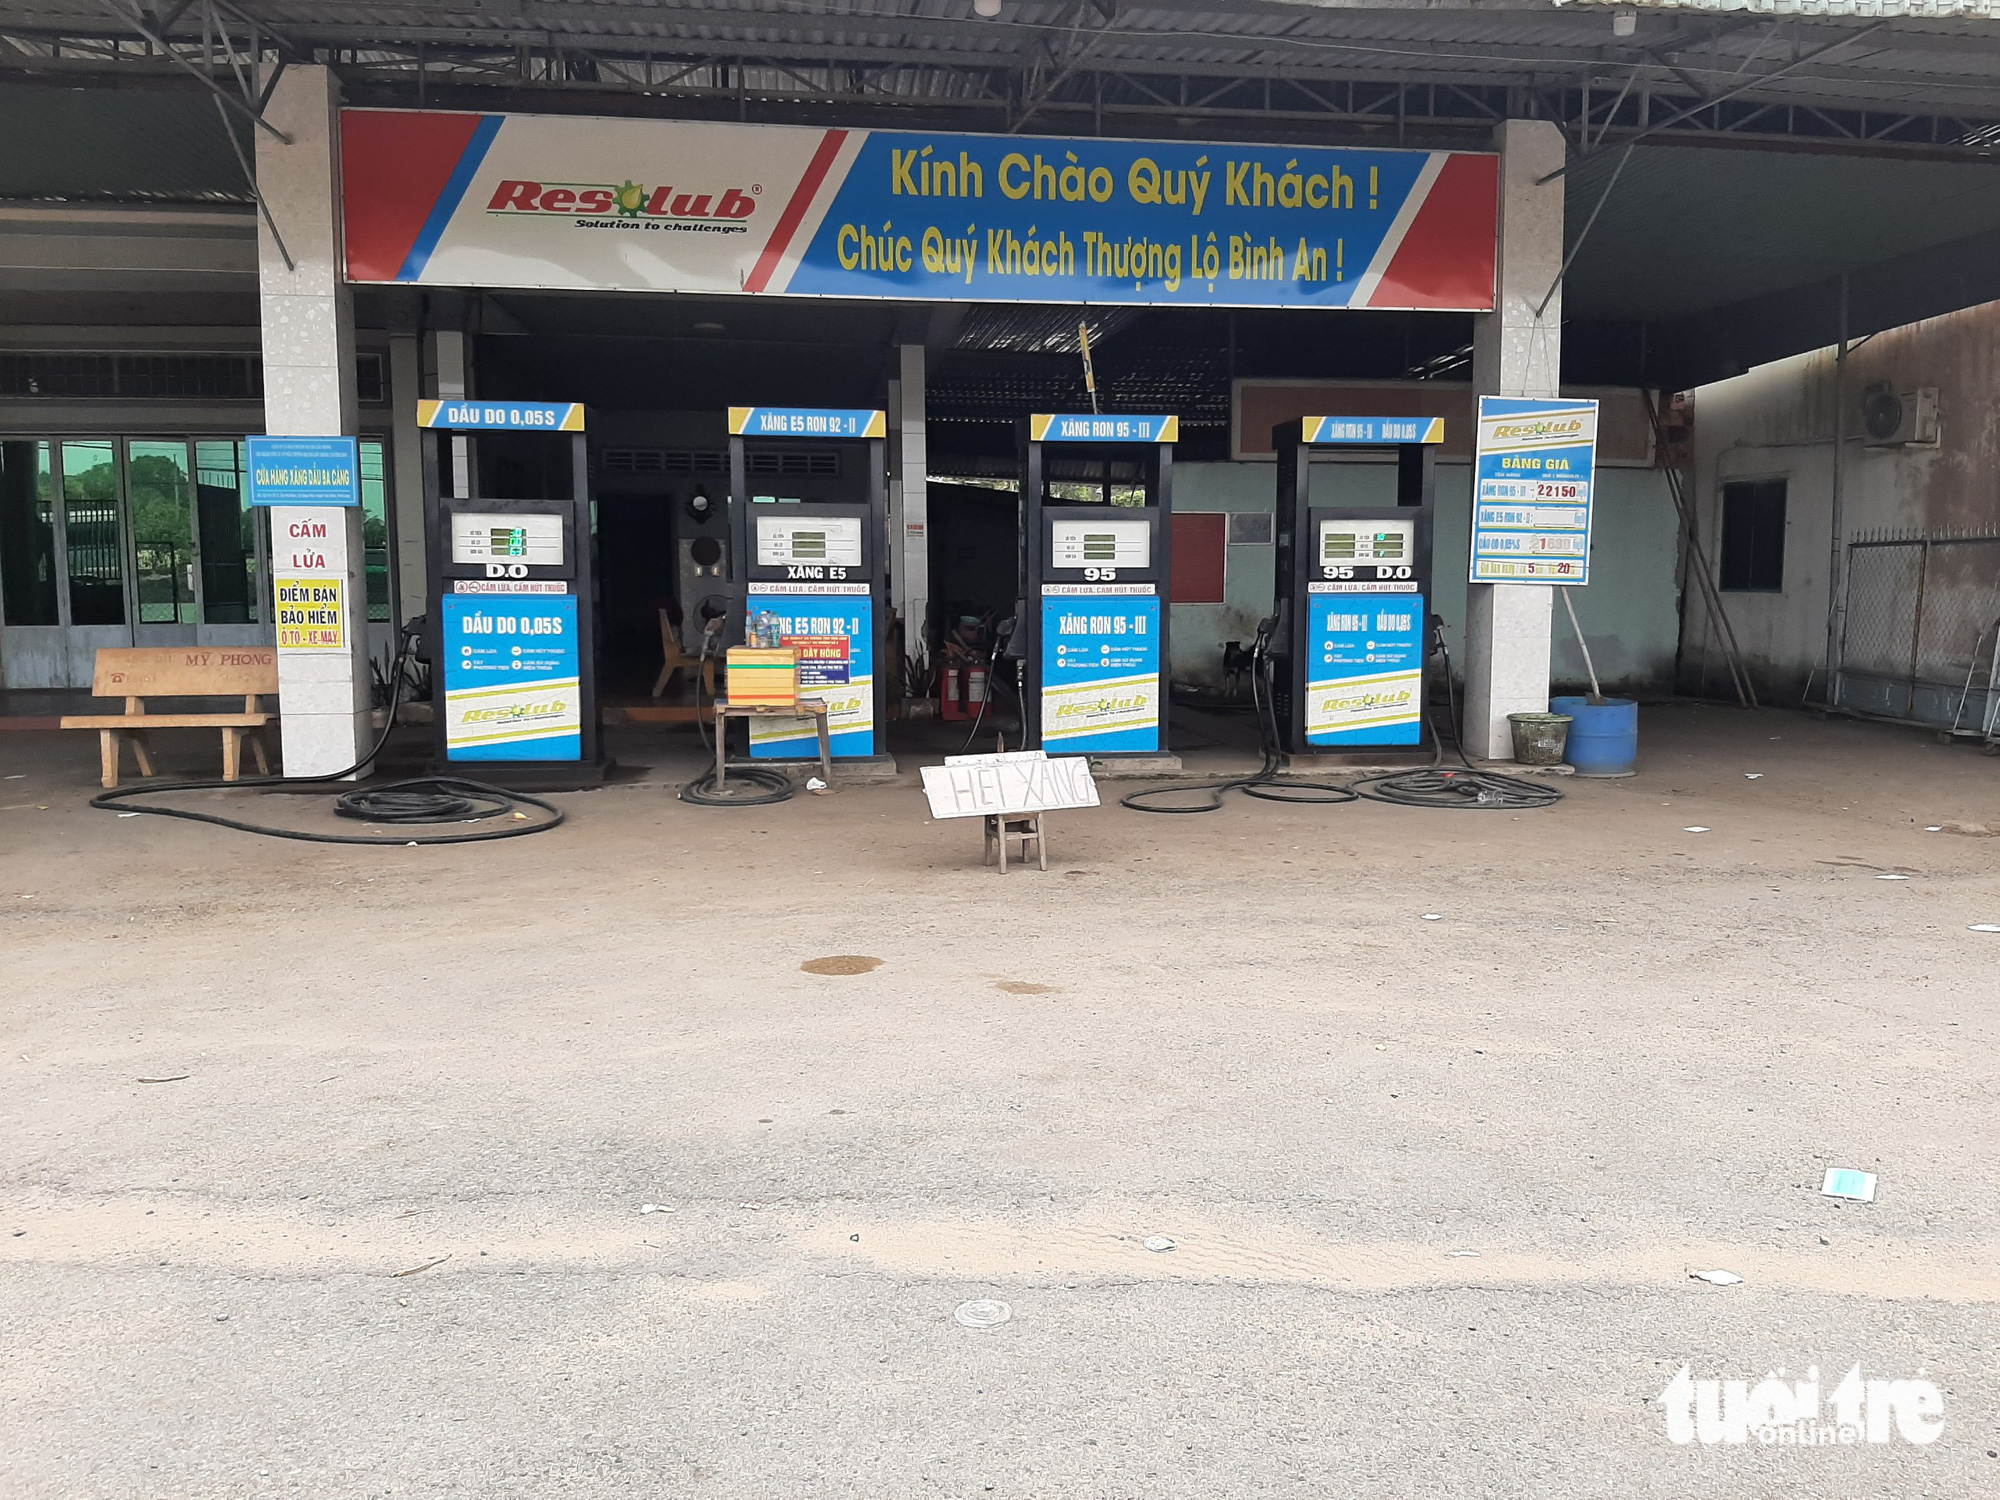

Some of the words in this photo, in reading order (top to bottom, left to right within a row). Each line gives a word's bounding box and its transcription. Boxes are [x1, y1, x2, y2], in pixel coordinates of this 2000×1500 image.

[892, 145, 983, 198] Kính
[999, 150, 1115, 203] Chào
[1127, 154, 1210, 216] Quý
[1226, 158, 1353, 210] Khách
[1368, 165, 1378, 210] !
[575, 219, 639, 232] Solution
[644, 221, 661, 232] to
[664, 222, 748, 234] challenges
[837, 219, 913, 272] Chúc
[921, 222, 978, 284] Quý
[988, 225, 1075, 277] Khách
[1084, 231, 1181, 292] Thượng
[1191, 231, 1220, 293] Lộ
[1229, 231, 1283, 281] Bình
[1292, 241, 1327, 282] An
[1336, 239, 1344, 281] !
[447, 402, 480, 424] DẦU
[485, 408, 506, 425] DO
[510, 409, 555, 427] 0,05S
[760, 411, 788, 432] XĂNG
[790, 415, 805, 432] E5
[807, 415, 827, 433] RON
[829, 416, 841, 433] 92
[1061, 419, 1090, 437] XĂNG
[1092, 421, 1114, 437] RON
[1116, 422, 1130, 438] 95
[1138, 422, 1150, 438] III
[1502, 456, 1542, 470] BẢNG
[1545, 457, 1570, 470] GIÁ
[1537, 484, 1576, 498] 22150
[289, 518, 327, 538] CẤM
[293, 548, 326, 568] LỬA
[486, 564, 529, 579] D.O
[829, 566, 847, 580] E5
[1083, 567, 1117, 581] 95
[1323, 566, 1354, 580] 95
[279, 581, 310, 602] ĐIỂM
[313, 585, 338, 602] BÁN
[280, 605, 305, 624] BẢO
[308, 603, 338, 624] HIỂM
[462, 611, 493, 634] DẦU
[496, 616, 517, 634] DO
[520, 616, 563, 636] 0,05S
[1059, 612, 1088, 635] XĂNG
[1090, 615, 1111, 635] RON
[1113, 615, 1127, 635] 95
[795, 617, 809, 635] E5
[811, 617, 831, 635] RON
[833, 616, 845, 636] 92
[308, 630, 318, 645] XE
[186, 651, 212, 667] MỸ
[220, 653, 273, 666] PHONG
